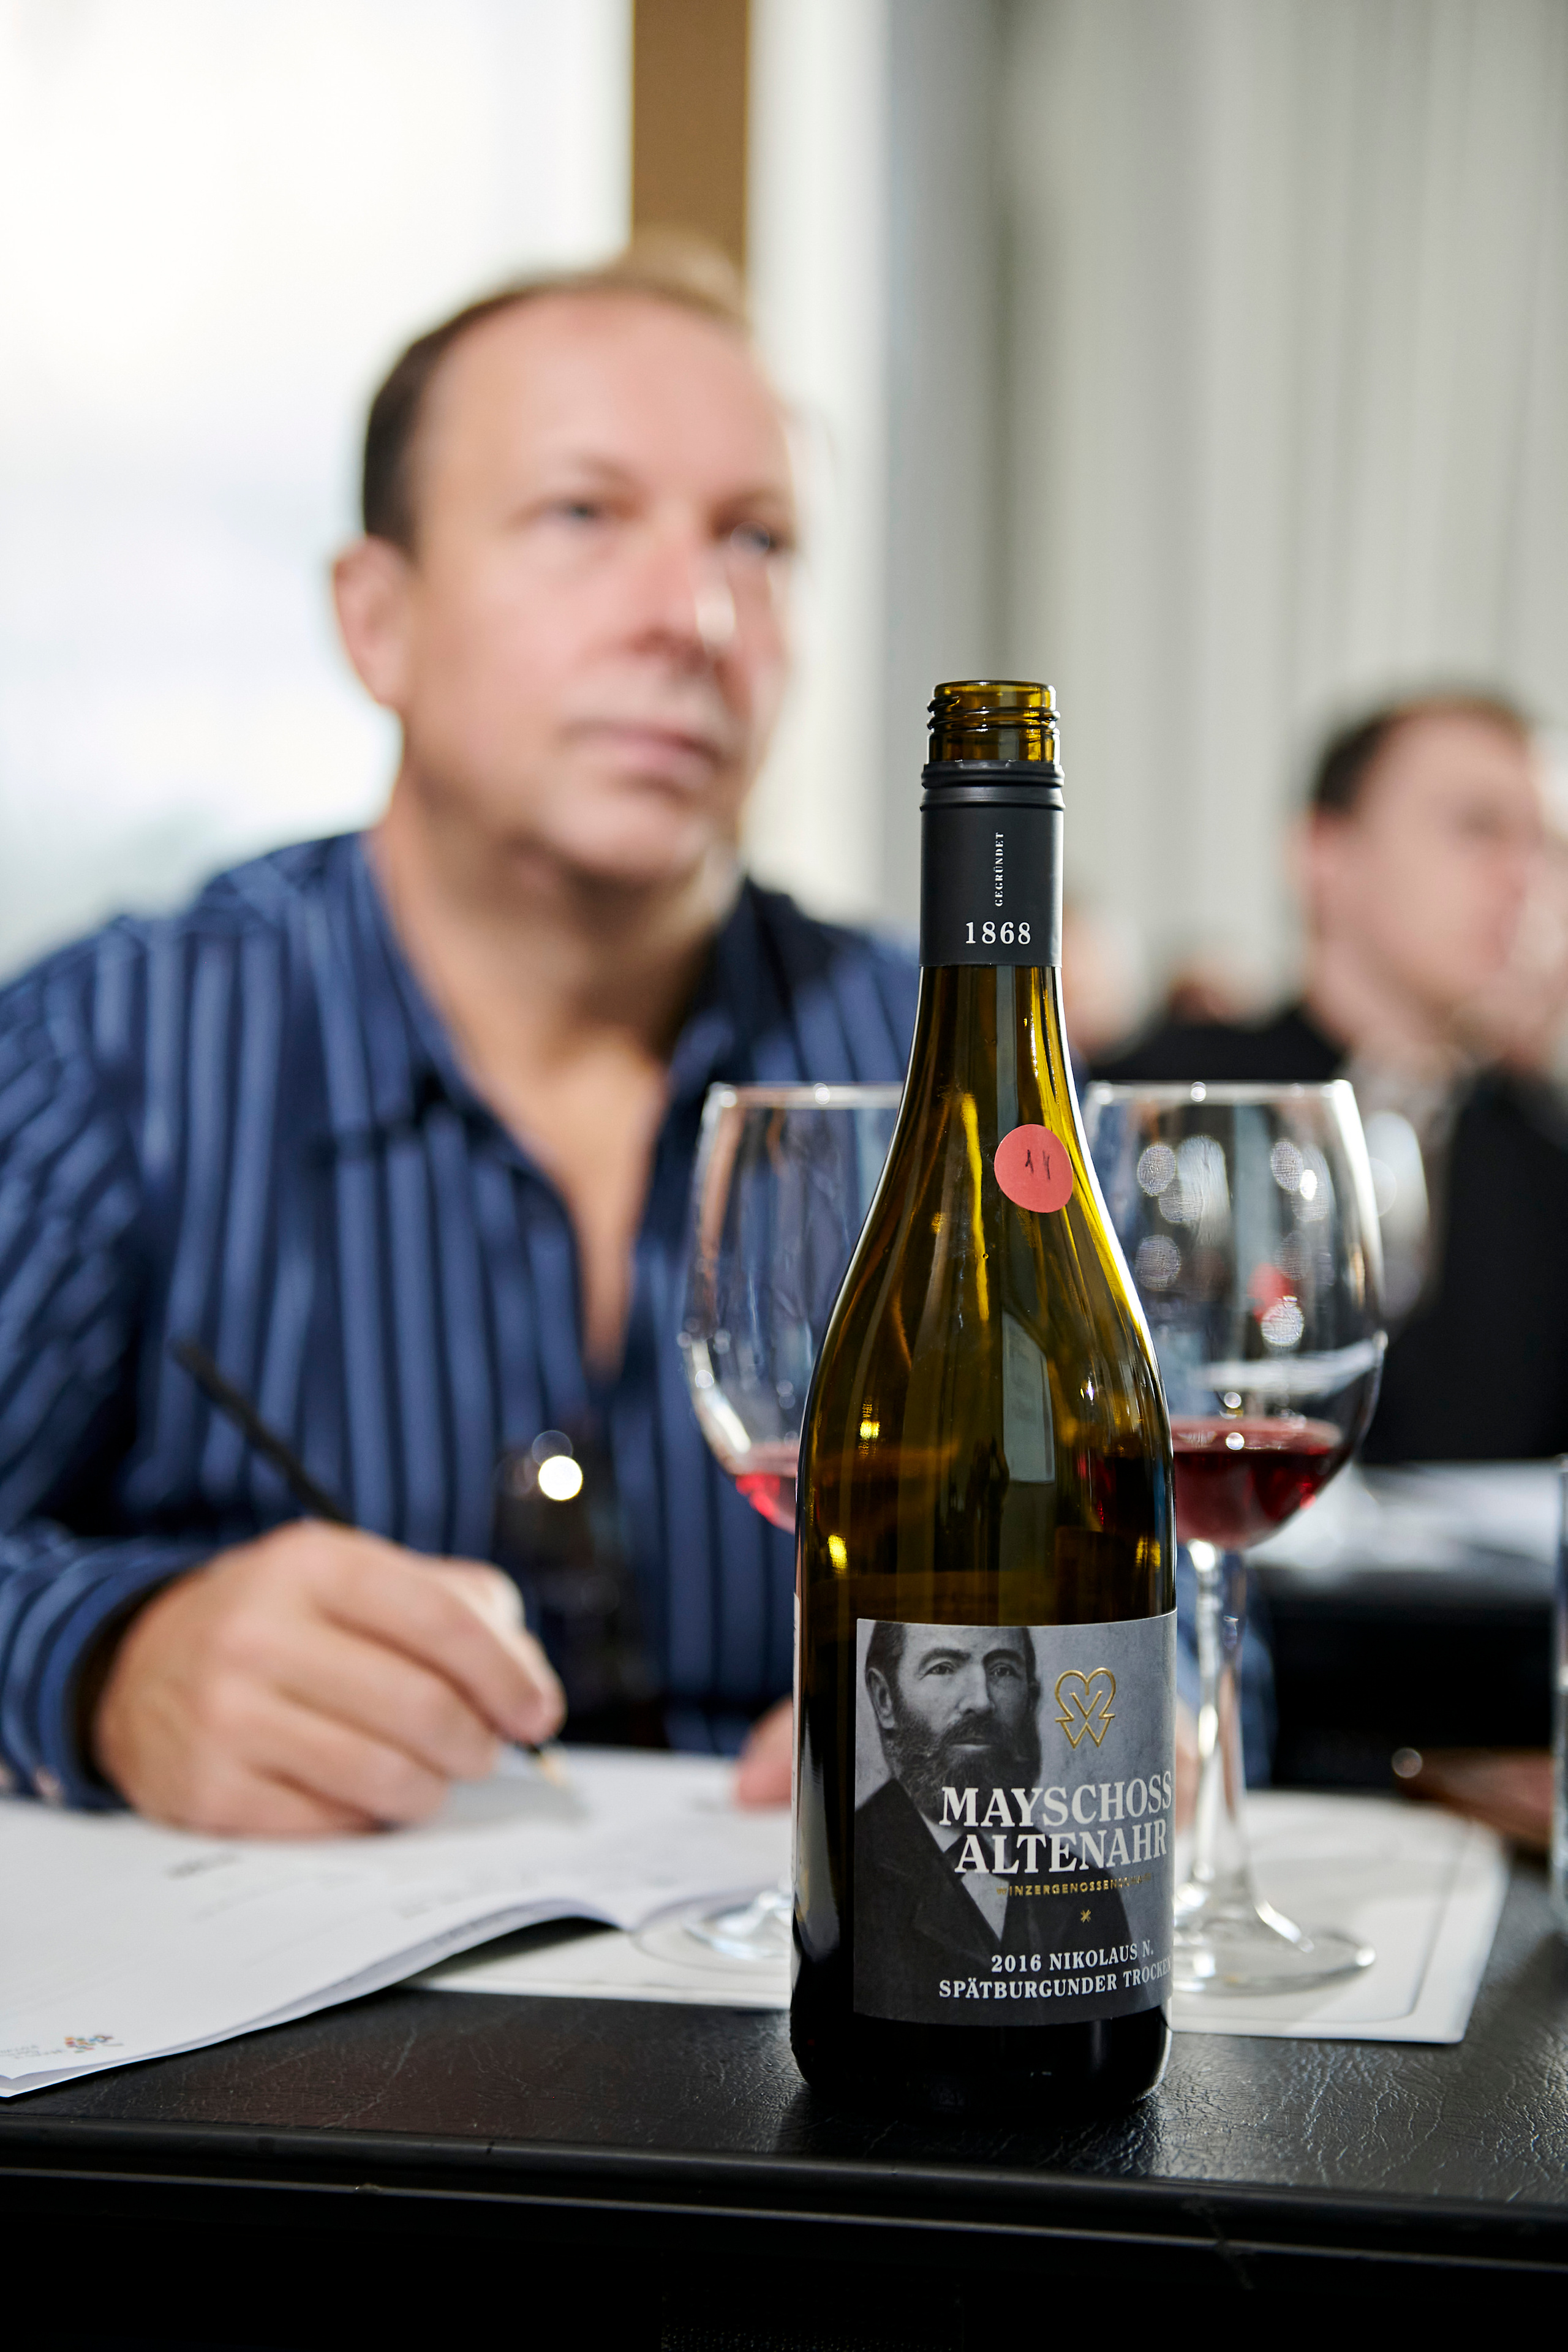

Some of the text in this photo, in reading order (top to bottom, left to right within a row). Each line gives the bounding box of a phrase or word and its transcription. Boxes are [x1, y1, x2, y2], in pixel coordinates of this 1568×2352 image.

[993, 832, 1005, 907] GEGRÜNDET
[965, 921, 1031, 944] 1868
[938, 1770, 1172, 1828] MAYSCHOSS
[954, 1819, 1167, 1874] ALTENAHR
[991, 1939, 1154, 1973] 2016 NIKOLAUS N.
[938, 1973, 1118, 1999] SPÄTBURGUNDER
